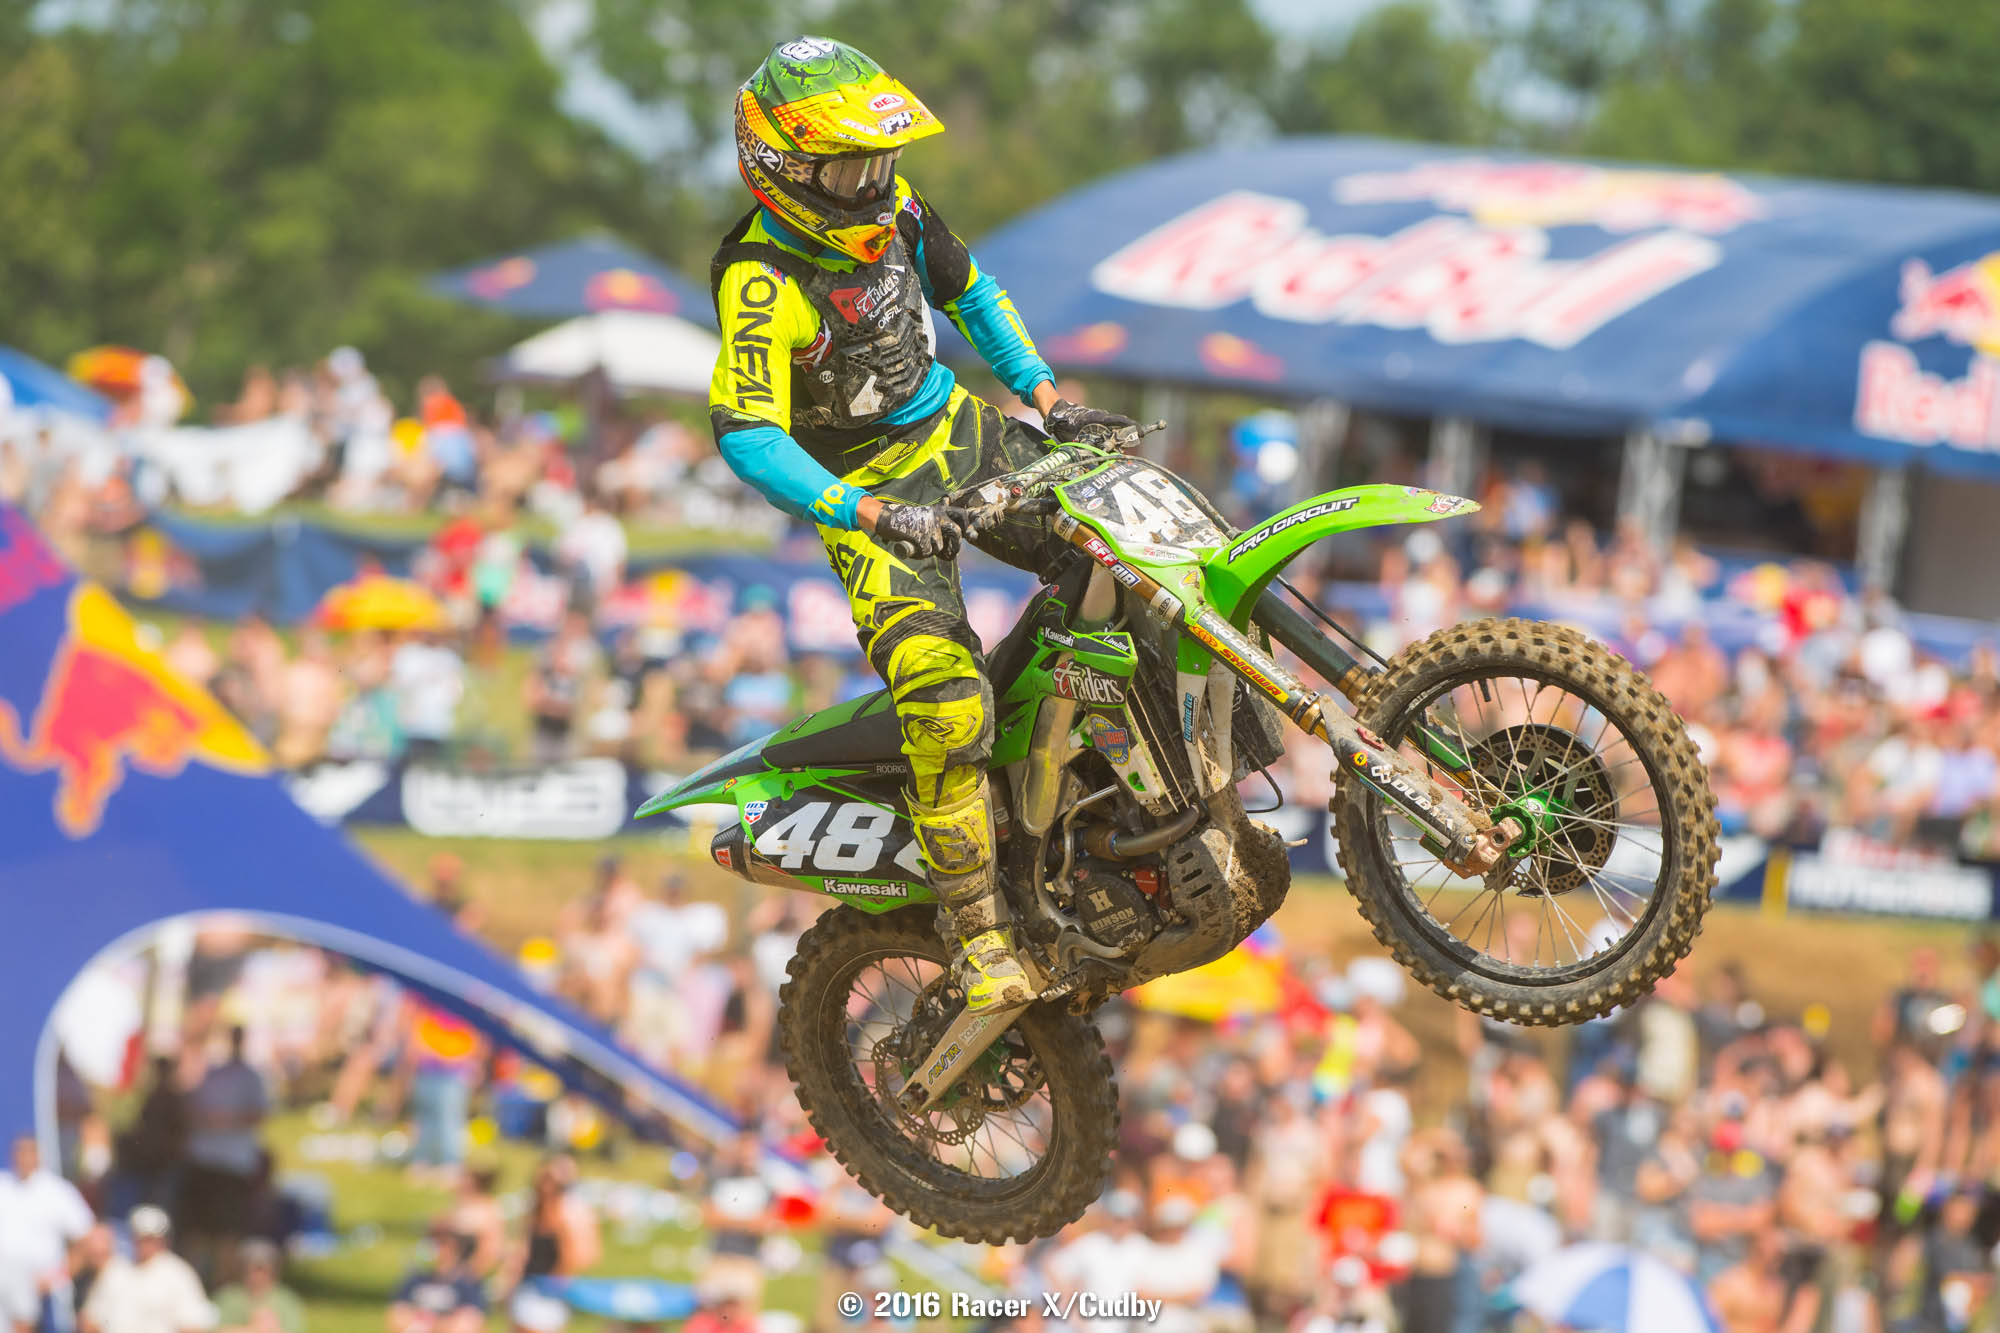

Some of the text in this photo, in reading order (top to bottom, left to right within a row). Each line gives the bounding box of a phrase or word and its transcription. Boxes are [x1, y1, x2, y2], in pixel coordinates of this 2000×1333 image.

[873, 96, 902, 109] BELL
[1111, 468, 1208, 543] 48
[1228, 529, 1270, 564] PRO
[1271, 497, 1360, 535] CIRCUIT
[1086, 538, 1119, 566] SFF
[1112, 562, 1140, 587] AIR
[1044, 626, 1075, 648] Kawasaki
[1220, 648, 1281, 696] SHOWA
[754, 801, 896, 872] 48
[823, 878, 908, 897] Kawasaki
